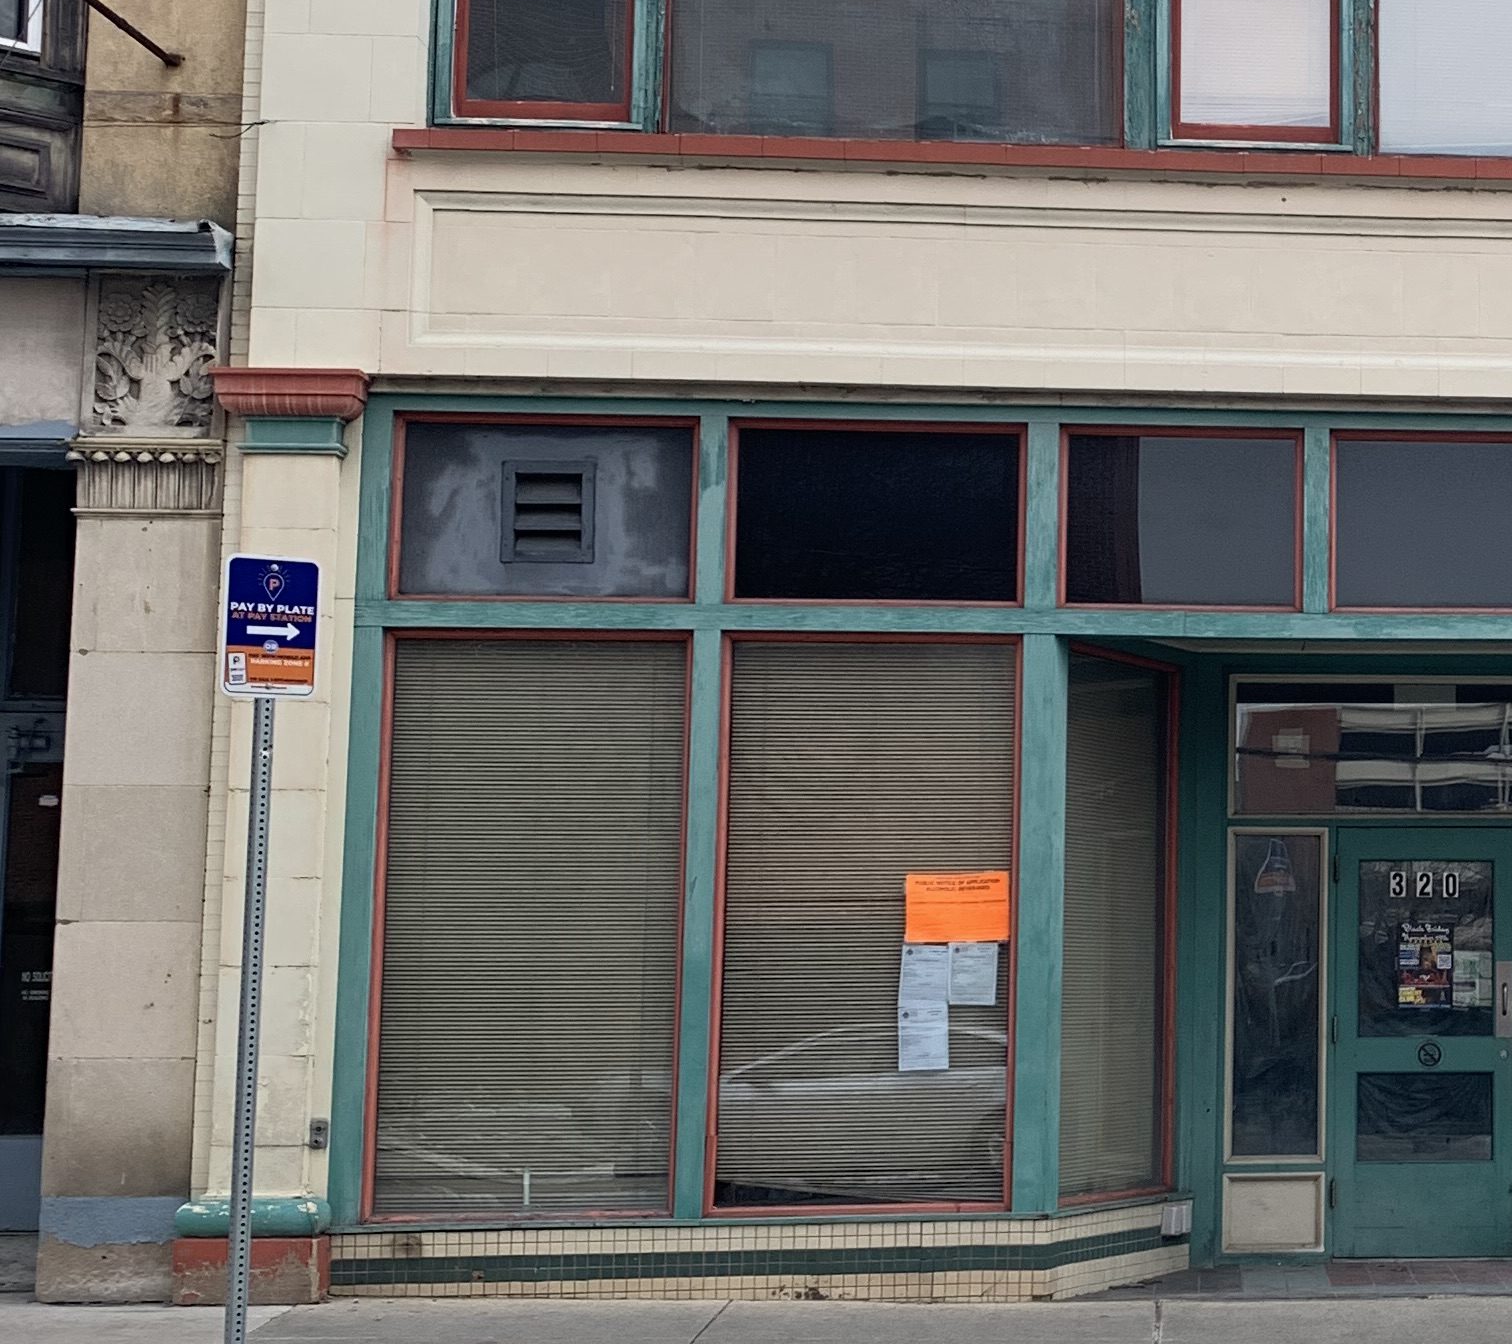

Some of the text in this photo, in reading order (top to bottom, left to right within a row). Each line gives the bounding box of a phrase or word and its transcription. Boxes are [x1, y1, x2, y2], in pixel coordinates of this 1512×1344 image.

[269, 578, 281, 591] P
[230, 601, 315, 615] PAY BY PLATE
[232, 611, 312, 623] AT PAY STATION
[283, 659, 303, 667] ZONE
[1392, 873, 1457, 896] 320
